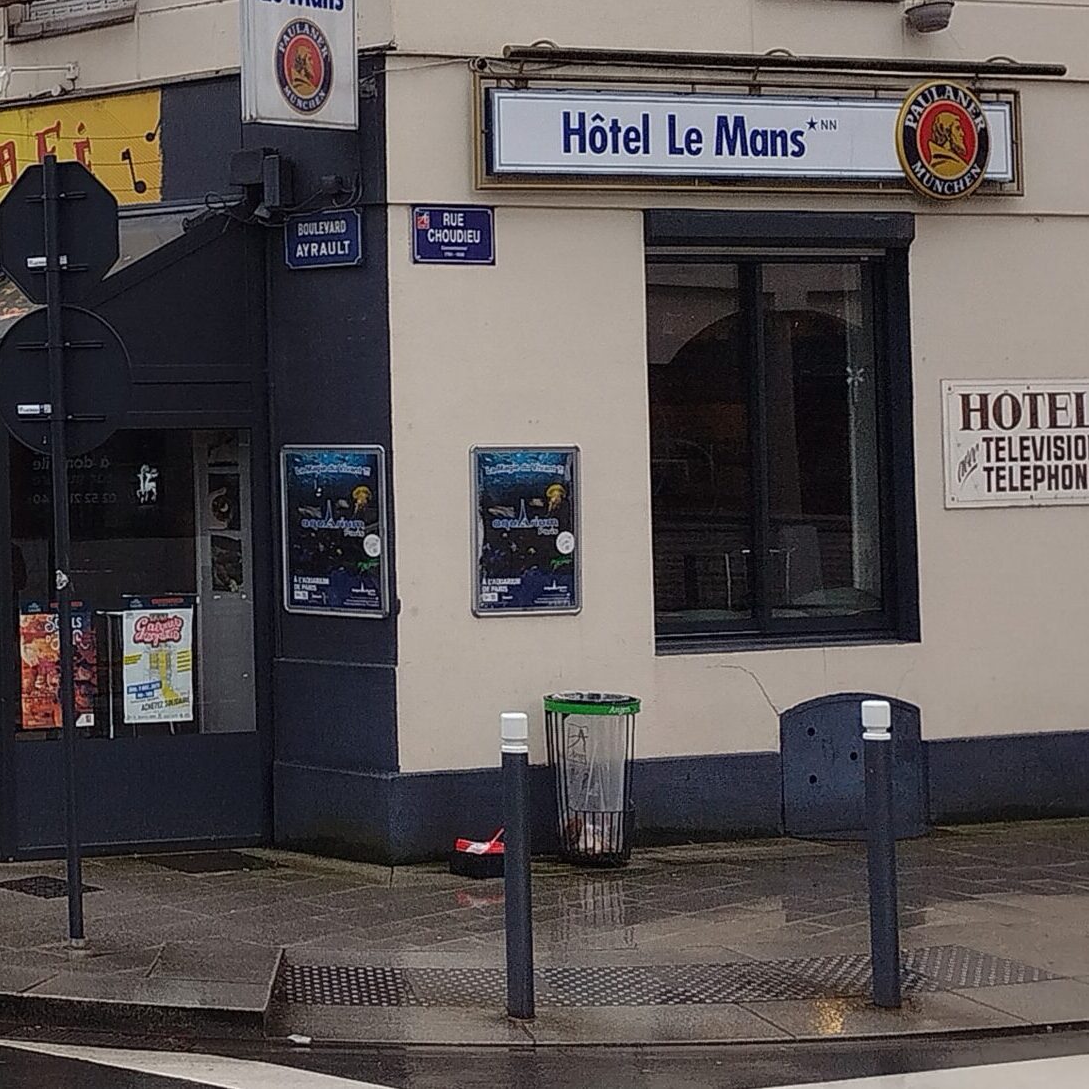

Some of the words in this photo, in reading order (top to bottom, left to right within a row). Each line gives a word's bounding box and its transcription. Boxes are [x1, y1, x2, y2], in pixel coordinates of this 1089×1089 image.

[278, 23, 329, 59] PAULANER
[905, 85, 985, 133] PAULANER
[563, 111, 650, 155] Hôtel
[668, 114, 703, 155] Le
[714, 115, 806, 158] Mans
[820, 119, 837, 131] NN
[297, 219, 347, 237] BOULEVARD
[443, 212, 464, 227] RUE
[295, 240, 350, 258] AYRAULT
[427, 228, 481, 243] CHOUDIEU
[958, 391, 1089, 432] HOTEL
[982, 434, 1089, 463] TELEVISIO
